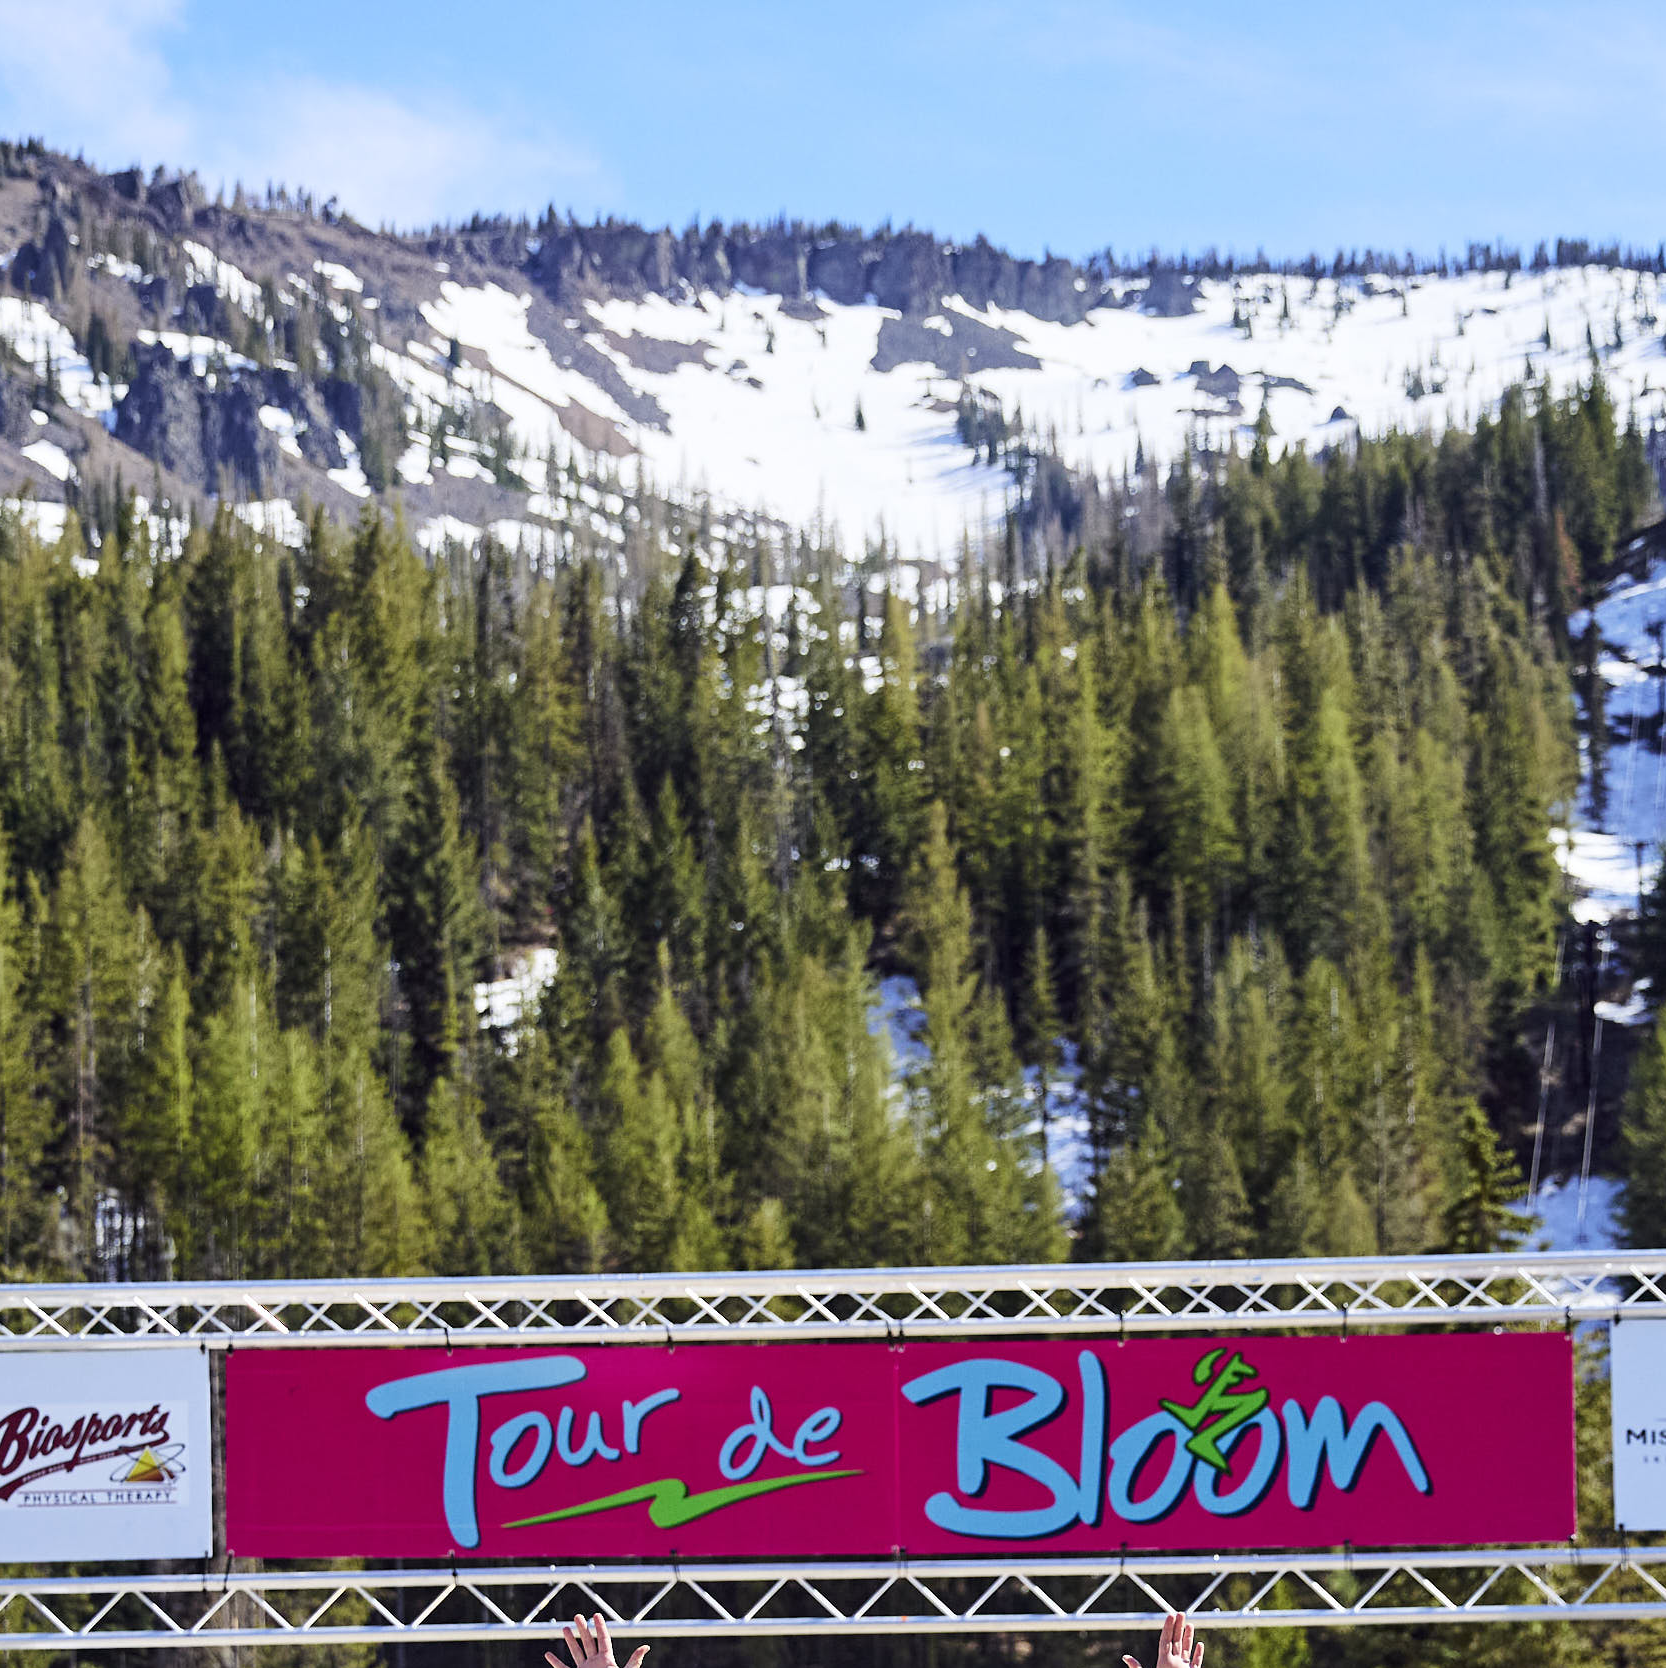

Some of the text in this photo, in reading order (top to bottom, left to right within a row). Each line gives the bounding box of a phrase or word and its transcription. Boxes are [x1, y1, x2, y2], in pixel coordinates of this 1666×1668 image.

[24, 1491, 171, 1504] PHYSICAL THERAPY
[365, 1350, 1432, 1549] Tour de Bloom
